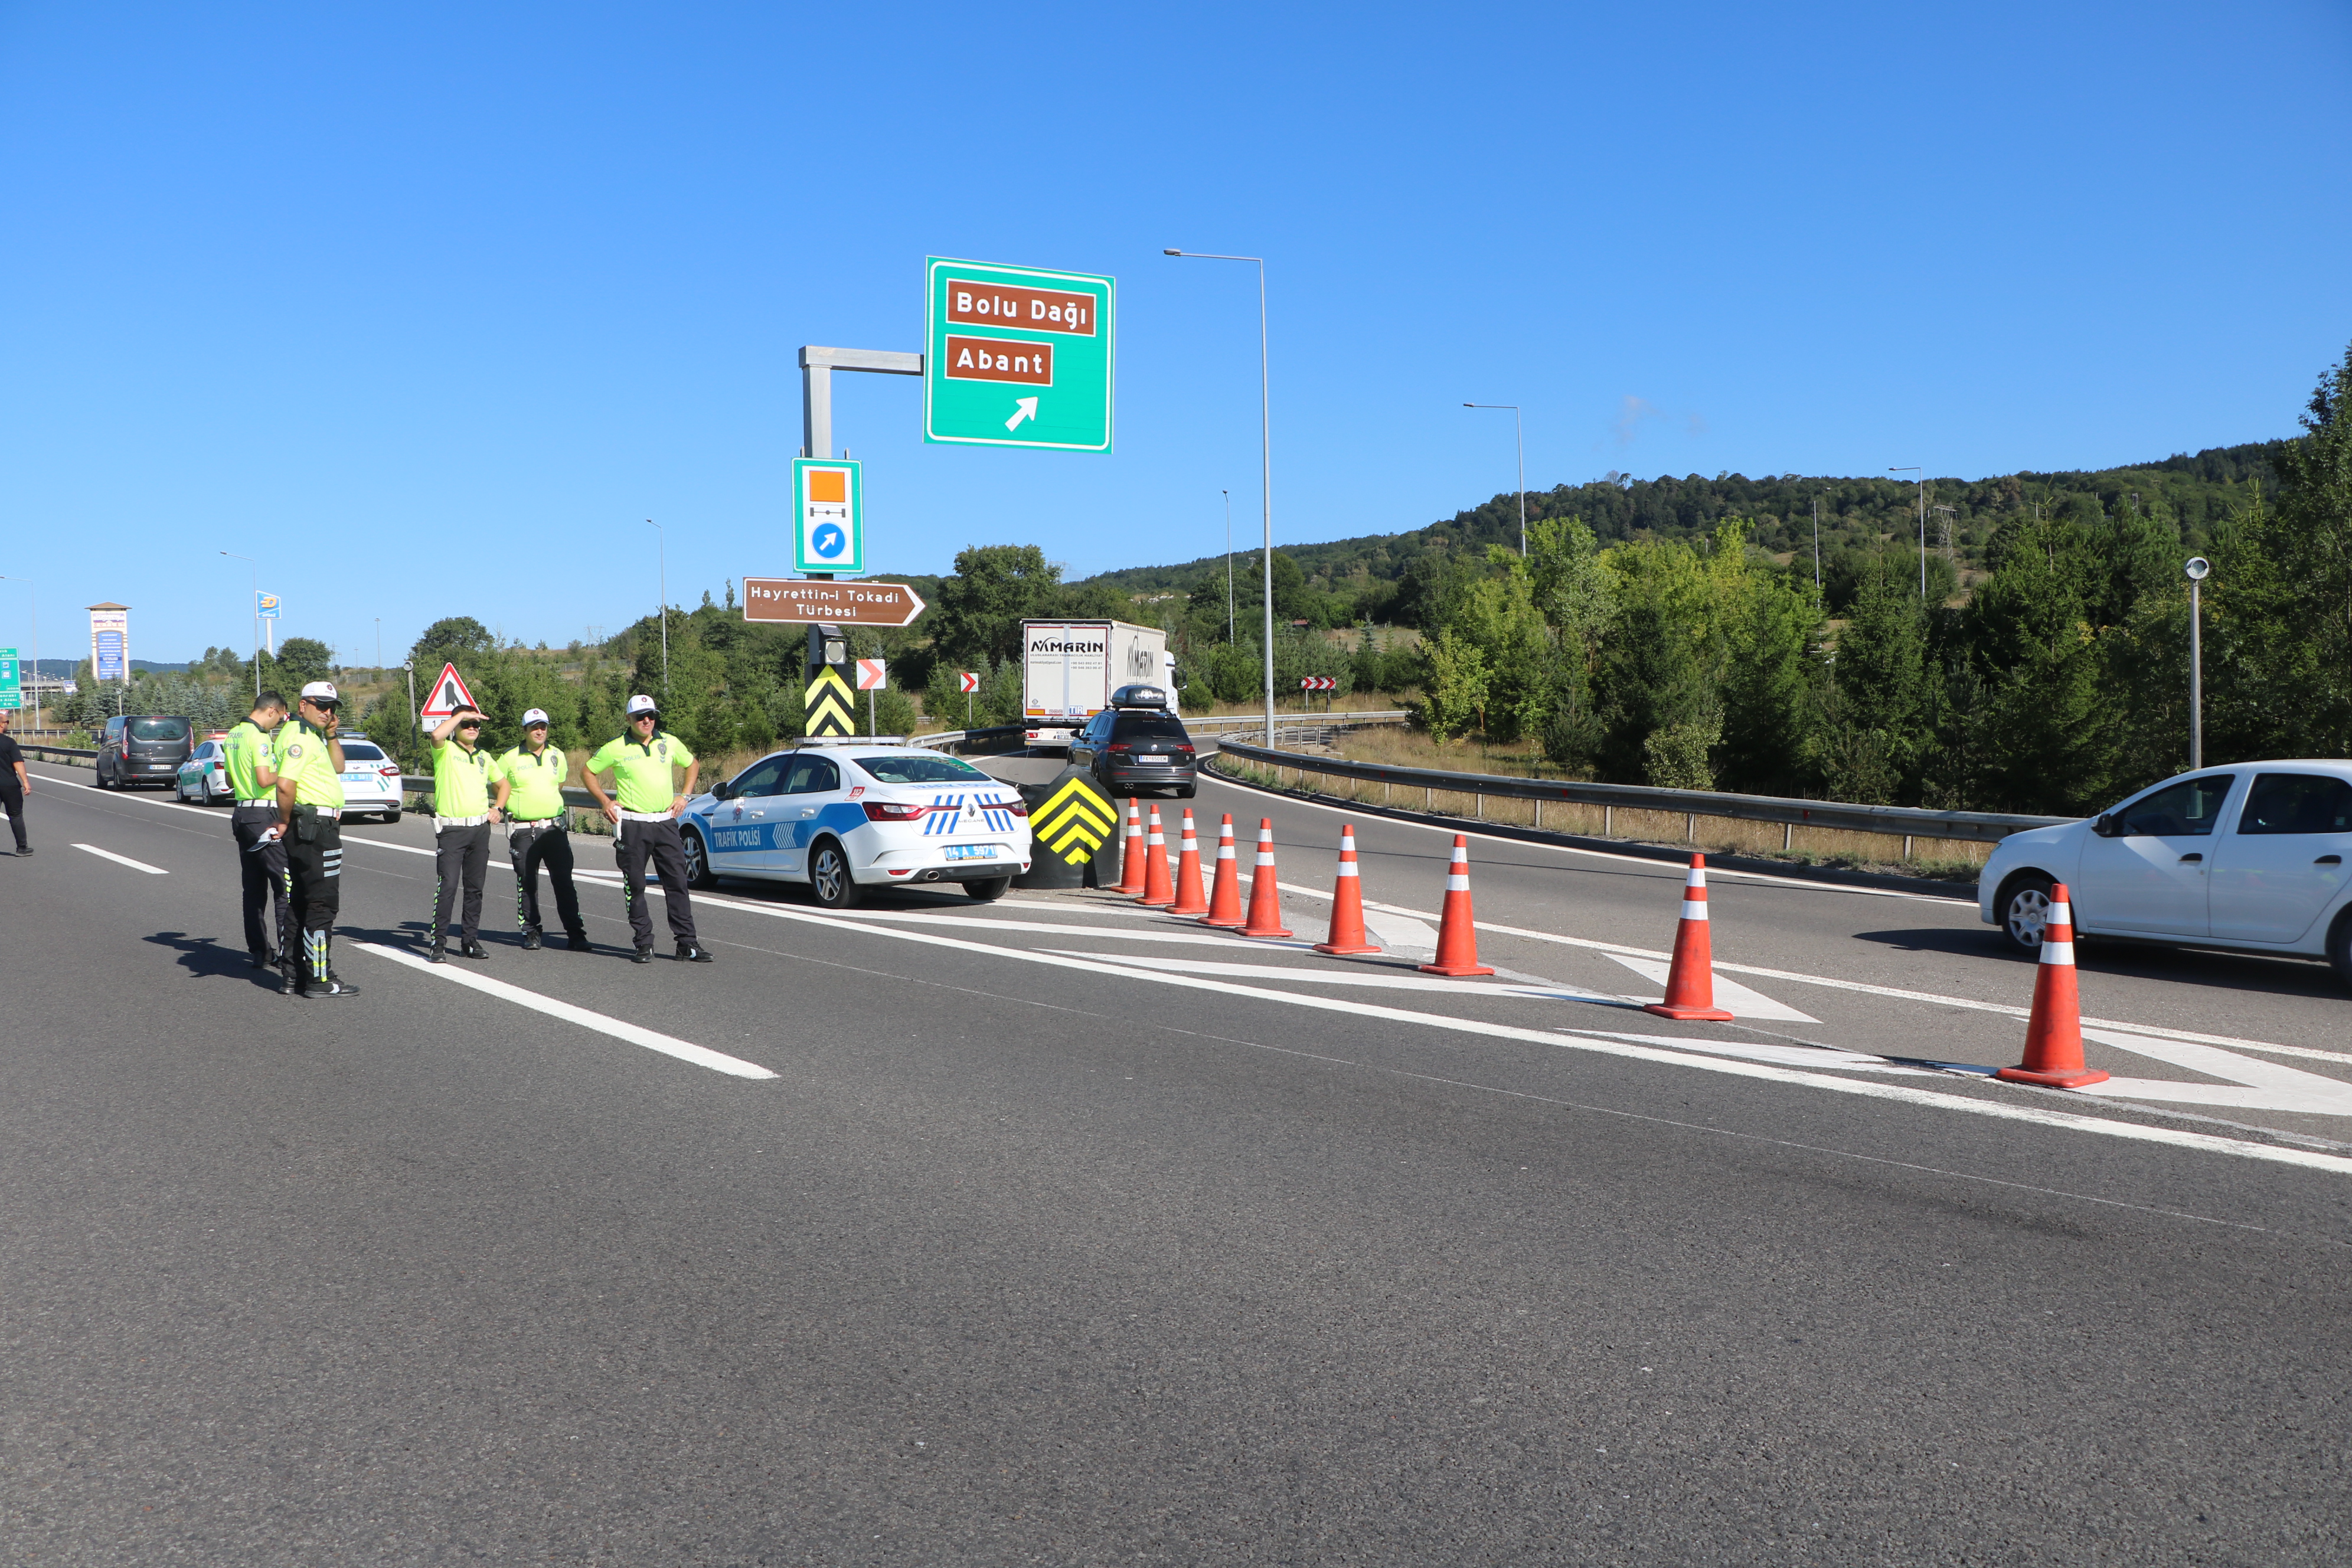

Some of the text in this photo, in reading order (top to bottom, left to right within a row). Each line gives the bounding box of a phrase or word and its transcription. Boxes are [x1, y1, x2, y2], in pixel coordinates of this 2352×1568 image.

[957, 292, 1086, 330] Bolu Dağı
[956, 348, 1043, 374] Abant
[751, 586, 899, 603] Hayrettin-i Tokadi
[796, 603, 857, 617] Türbesi
[1069, 705, 1083, 714] TIR
[714, 827, 760, 848] TRAFİK POLİSİ
[946, 844, 995, 857] 14 A 5971
